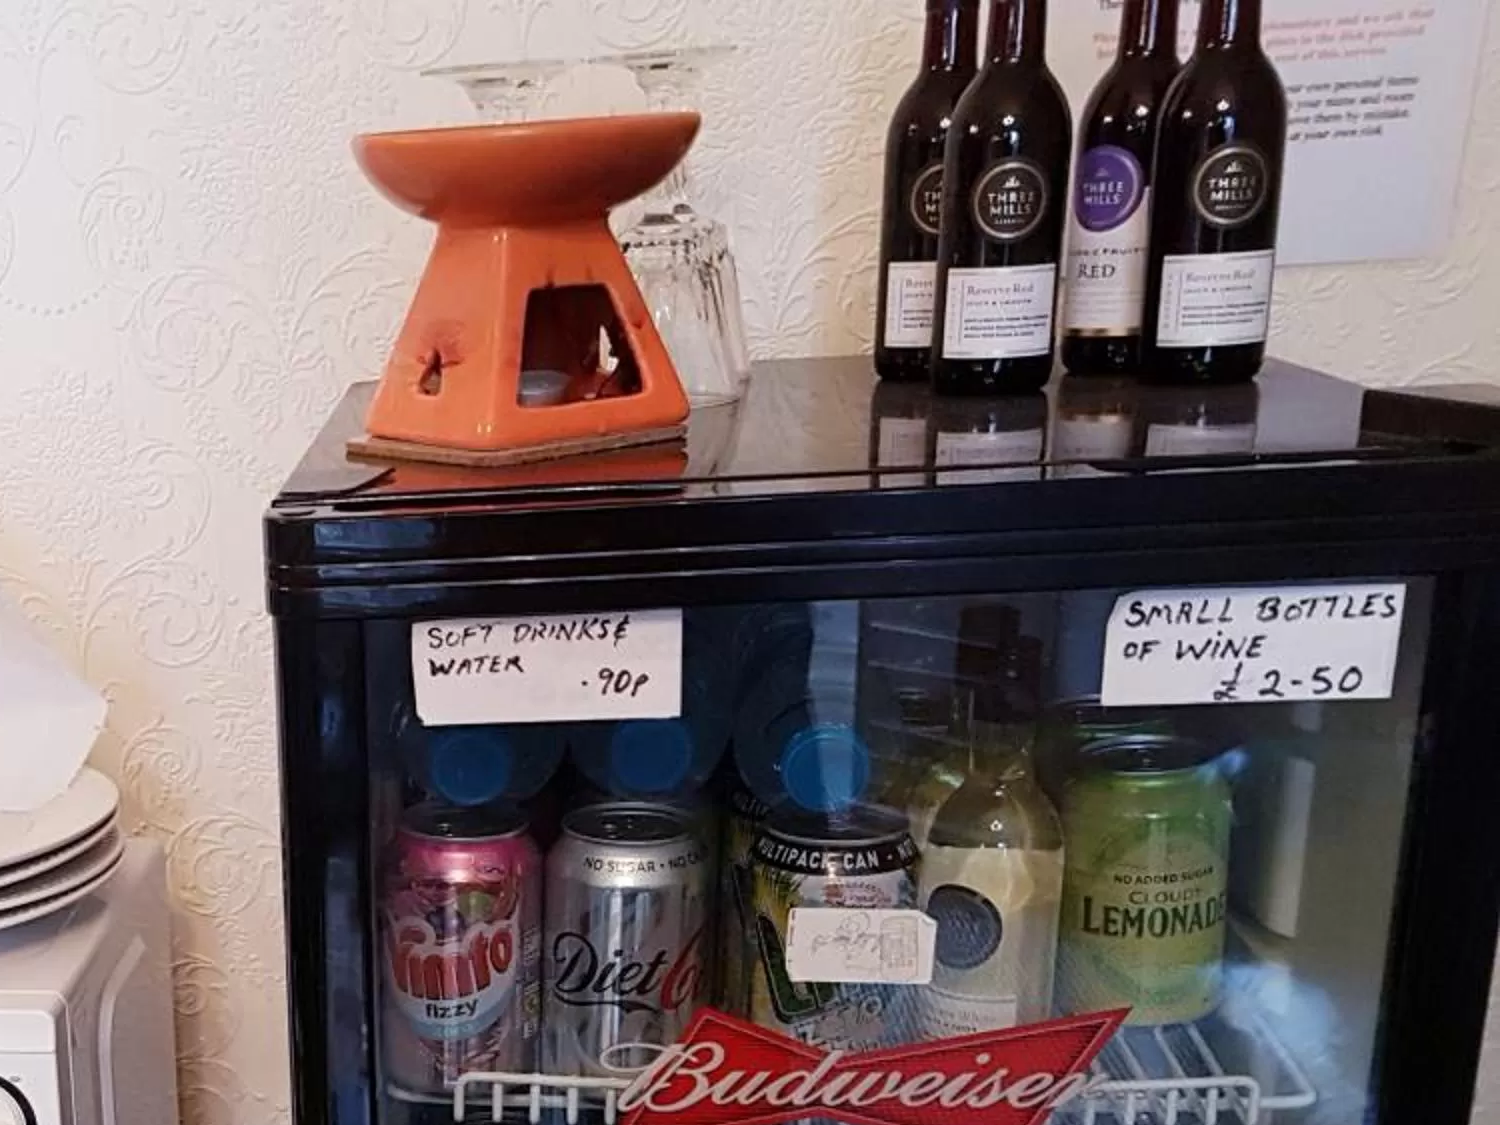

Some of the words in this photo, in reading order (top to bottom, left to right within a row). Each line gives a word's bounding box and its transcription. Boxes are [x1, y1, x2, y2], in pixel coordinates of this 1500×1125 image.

[988, 191, 1035, 204] THREE
[1083, 194, 1122, 206] MILLS
[1210, 189, 1254, 202] MILLS
[989, 203, 1033, 217] MILLS
[1076, 263, 1116, 278] RED
[1123, 597, 1235, 628] SMALL
[1255, 592, 1398, 622] BOTTLES
[426, 623, 494, 649] SOFT
[1122, 639, 1161, 661] OF
[427, 654, 526, 678] WATER
[583, 855, 603, 872] NO
[842, 850, 880, 870] CAN
[1113, 874, 1132, 885] NO
[1135, 872, 1179, 886] ADDED
[553, 932, 669, 1008] Diet
[424, 998, 481, 1019] fizzy
[599, 1041, 1100, 1113] Budweiser
